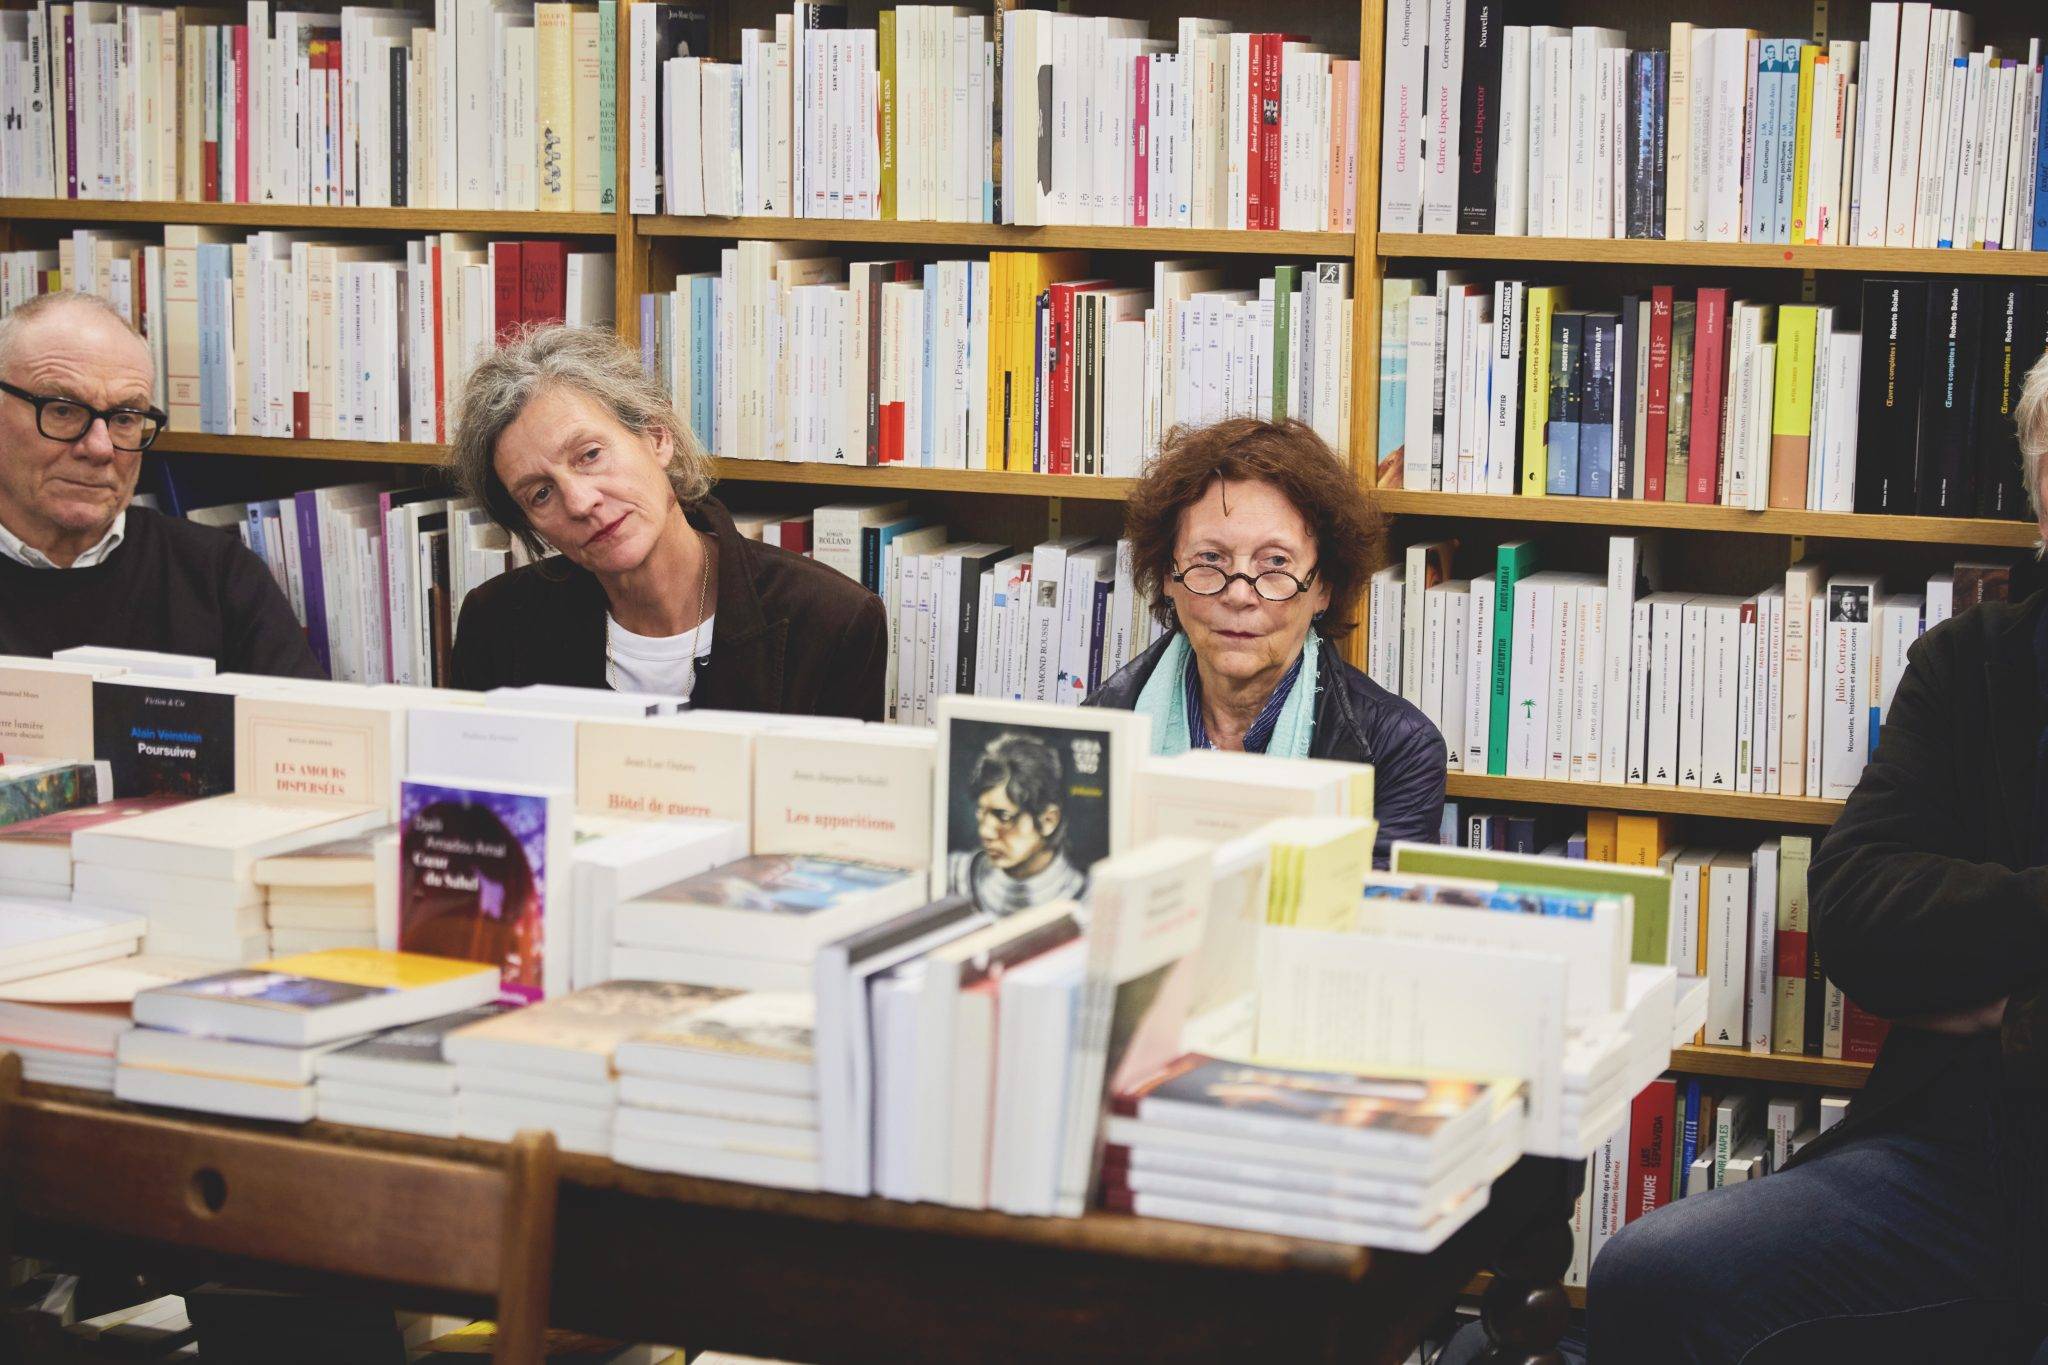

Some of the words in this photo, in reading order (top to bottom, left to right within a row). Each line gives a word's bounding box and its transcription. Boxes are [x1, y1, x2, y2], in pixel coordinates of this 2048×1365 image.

[1479, 6, 1489, 48] Nouvelles
[1397, 84, 1409, 133] Lispector
[1438, 86, 1449, 134] Lispector
[1474, 86, 1486, 133] Lispector
[1396, 137, 1406, 172] Clarice
[1437, 138, 1447, 174] Clarice
[1473, 137, 1484, 174] Clarice
[1964, 138, 1972, 176] message
[1891, 289, 1899, 312] Bolaño
[1950, 288, 1959, 311] Bolaño
[2006, 292, 2014, 315] Bolaño
[1889, 313, 1898, 340] Roberto
[1949, 312, 1958, 339] Roberto
[2005, 316, 2013, 342] Roberto
[955, 338, 964, 375] Passage
[1594, 343, 1602, 370] ROBERTO
[1887, 346, 1897, 380] complètes
[1946, 348, 1956, 381] complètes
[955, 378, 963, 390] Le
[2002, 354, 2012, 387] complètes
[1886, 381, 1895, 407] Œuvres
[1945, 382, 1954, 408] Œuvres
[2001, 389, 2010, 414] Œuvres
[819, 537, 851, 546] ROLLAND
[1040, 617, 1050, 654] ROUSSEL
[1561, 630, 1567, 638] LA
[1596, 625, 1601, 633] LA
[1497, 638, 1506, 676] CARPENTIER
[1836, 628, 1847, 674] Cortázar
[1037, 656, 1047, 701] RAYMOND
[1496, 678, 1505, 696] ALEJO
[1835, 678, 1848, 704] Julio
[1849, 675, 1856, 683] et
[1848, 684, 1856, 715] histoires
[131, 727, 156, 740] Alain
[157, 729, 203, 744] Veinstein
[1847, 716, 1855, 752] Nouvelles,
[137, 742, 197, 759] Poursuivre
[275, 762, 296, 776] LES
[299, 764, 347, 780] AMOURS
[667, 800, 712, 818] guerre
[785, 808, 810, 825] Les
[812, 810, 896, 832] apparitions
[1719, 1125, 1728, 1153] NAPLES
[1603, 1145, 1612, 1179] s'appelait
[1641, 1148, 1650, 1167] LUIS
[1604, 1180, 1612, 1192] qui
[1612, 1161, 1621, 1191] Sánchez
[1600, 1193, 1610, 1235] L'anarchiste
[1610, 1217, 1619, 1235] Pablo
